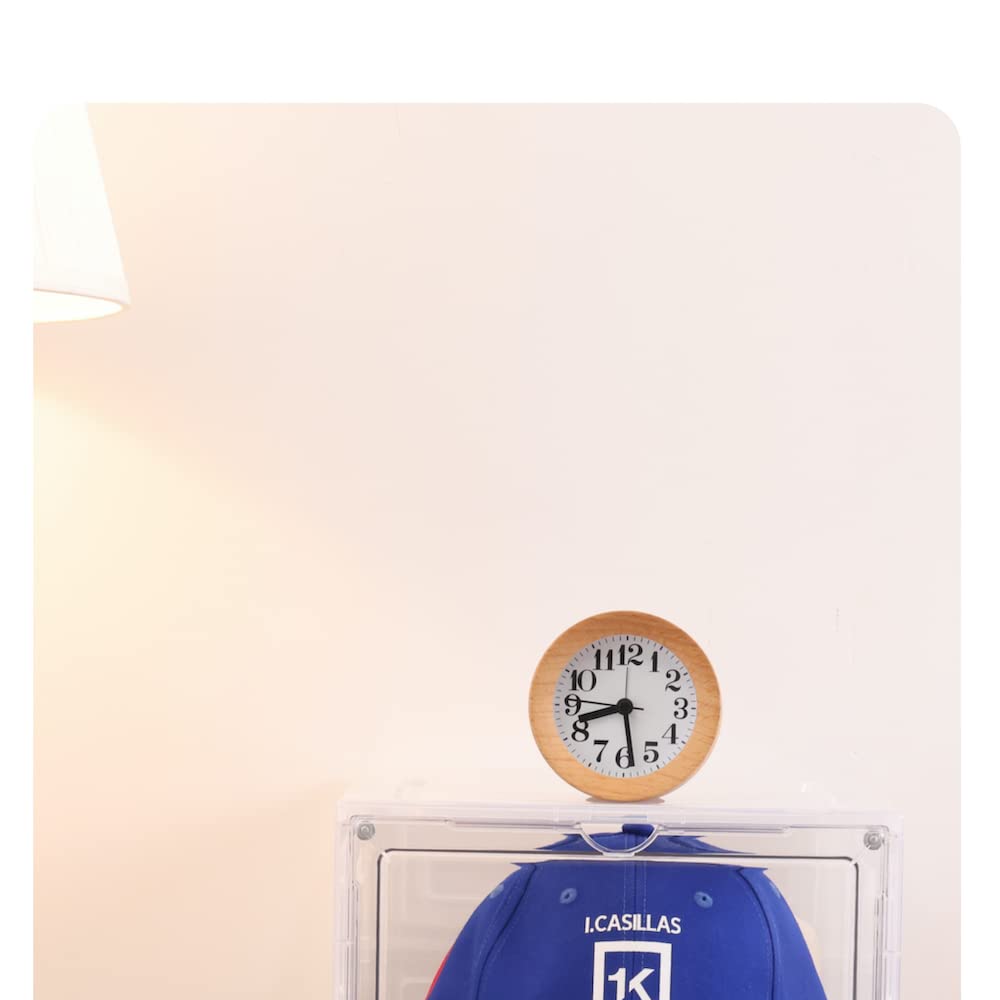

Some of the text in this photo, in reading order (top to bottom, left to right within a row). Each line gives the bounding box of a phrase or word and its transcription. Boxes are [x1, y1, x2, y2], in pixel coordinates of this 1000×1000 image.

[593, 648, 615, 671] 11
[616, 643, 644, 666] 12
[649, 651, 660, 672] 1
[570, 669, 597, 692] 10
[665, 669, 681, 692] 2
[564, 693, 582, 716] 9
[673, 697, 689, 719] 3
[571, 719, 589, 742] 8
[661, 723, 679, 745] 4
[593, 740, 609, 763] 7
[615, 746, 632, 769] 6
[643, 741, 659, 763] 5
[584, 913, 682, 935] I.CASILLAS
